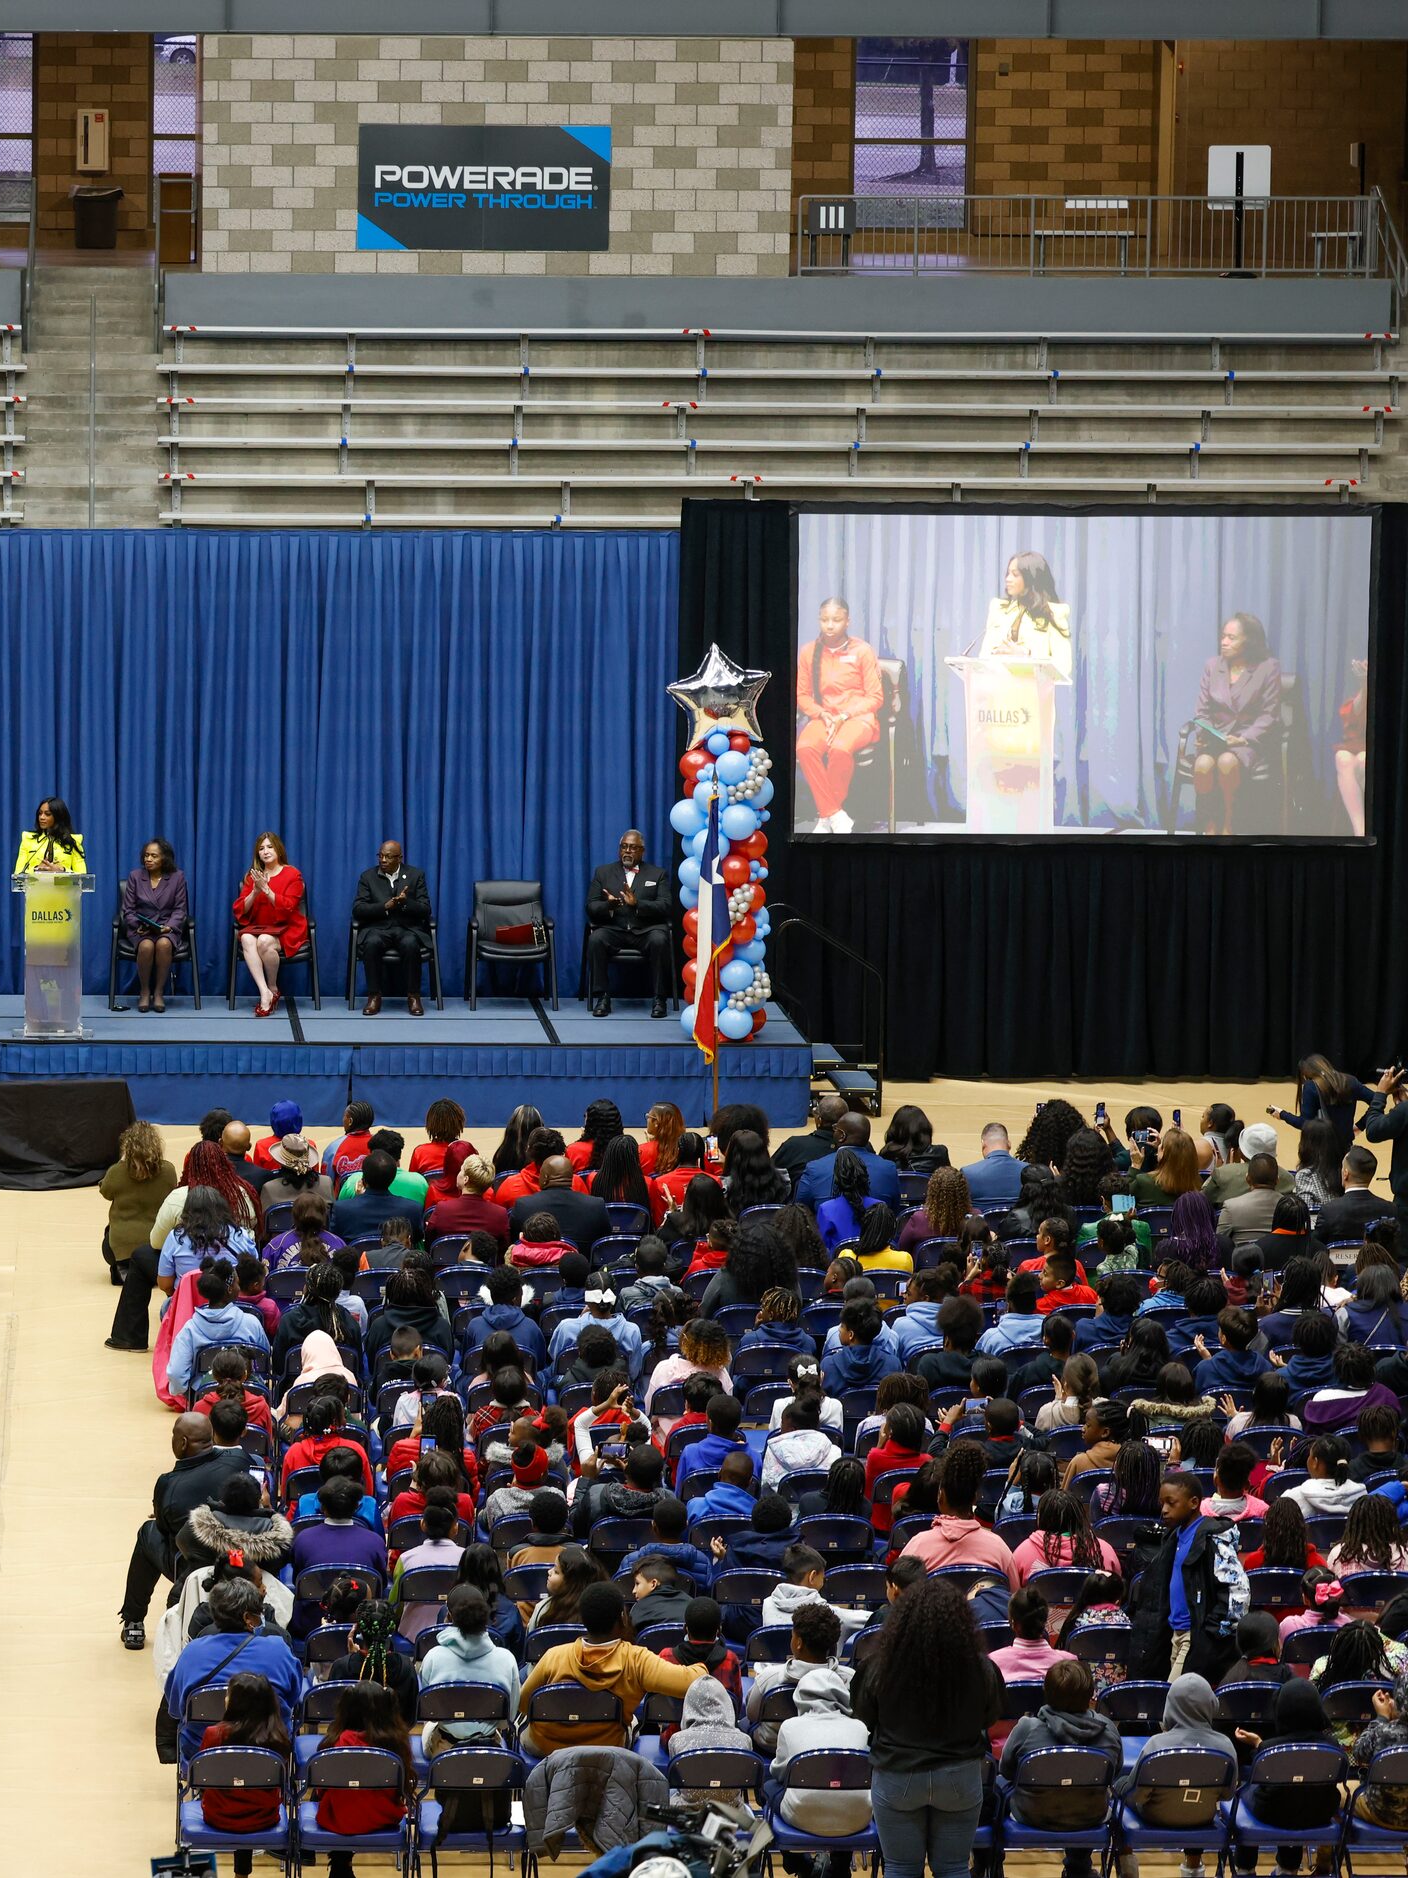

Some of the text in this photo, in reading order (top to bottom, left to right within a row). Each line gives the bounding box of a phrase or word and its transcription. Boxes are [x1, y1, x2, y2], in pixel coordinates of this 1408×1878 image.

[374, 164, 593, 191] POWERADE
[374, 191, 592, 209] POWER THROUGH
[978, 709, 1019, 724] DALLAS
[31, 910, 64, 921] DALLAS
